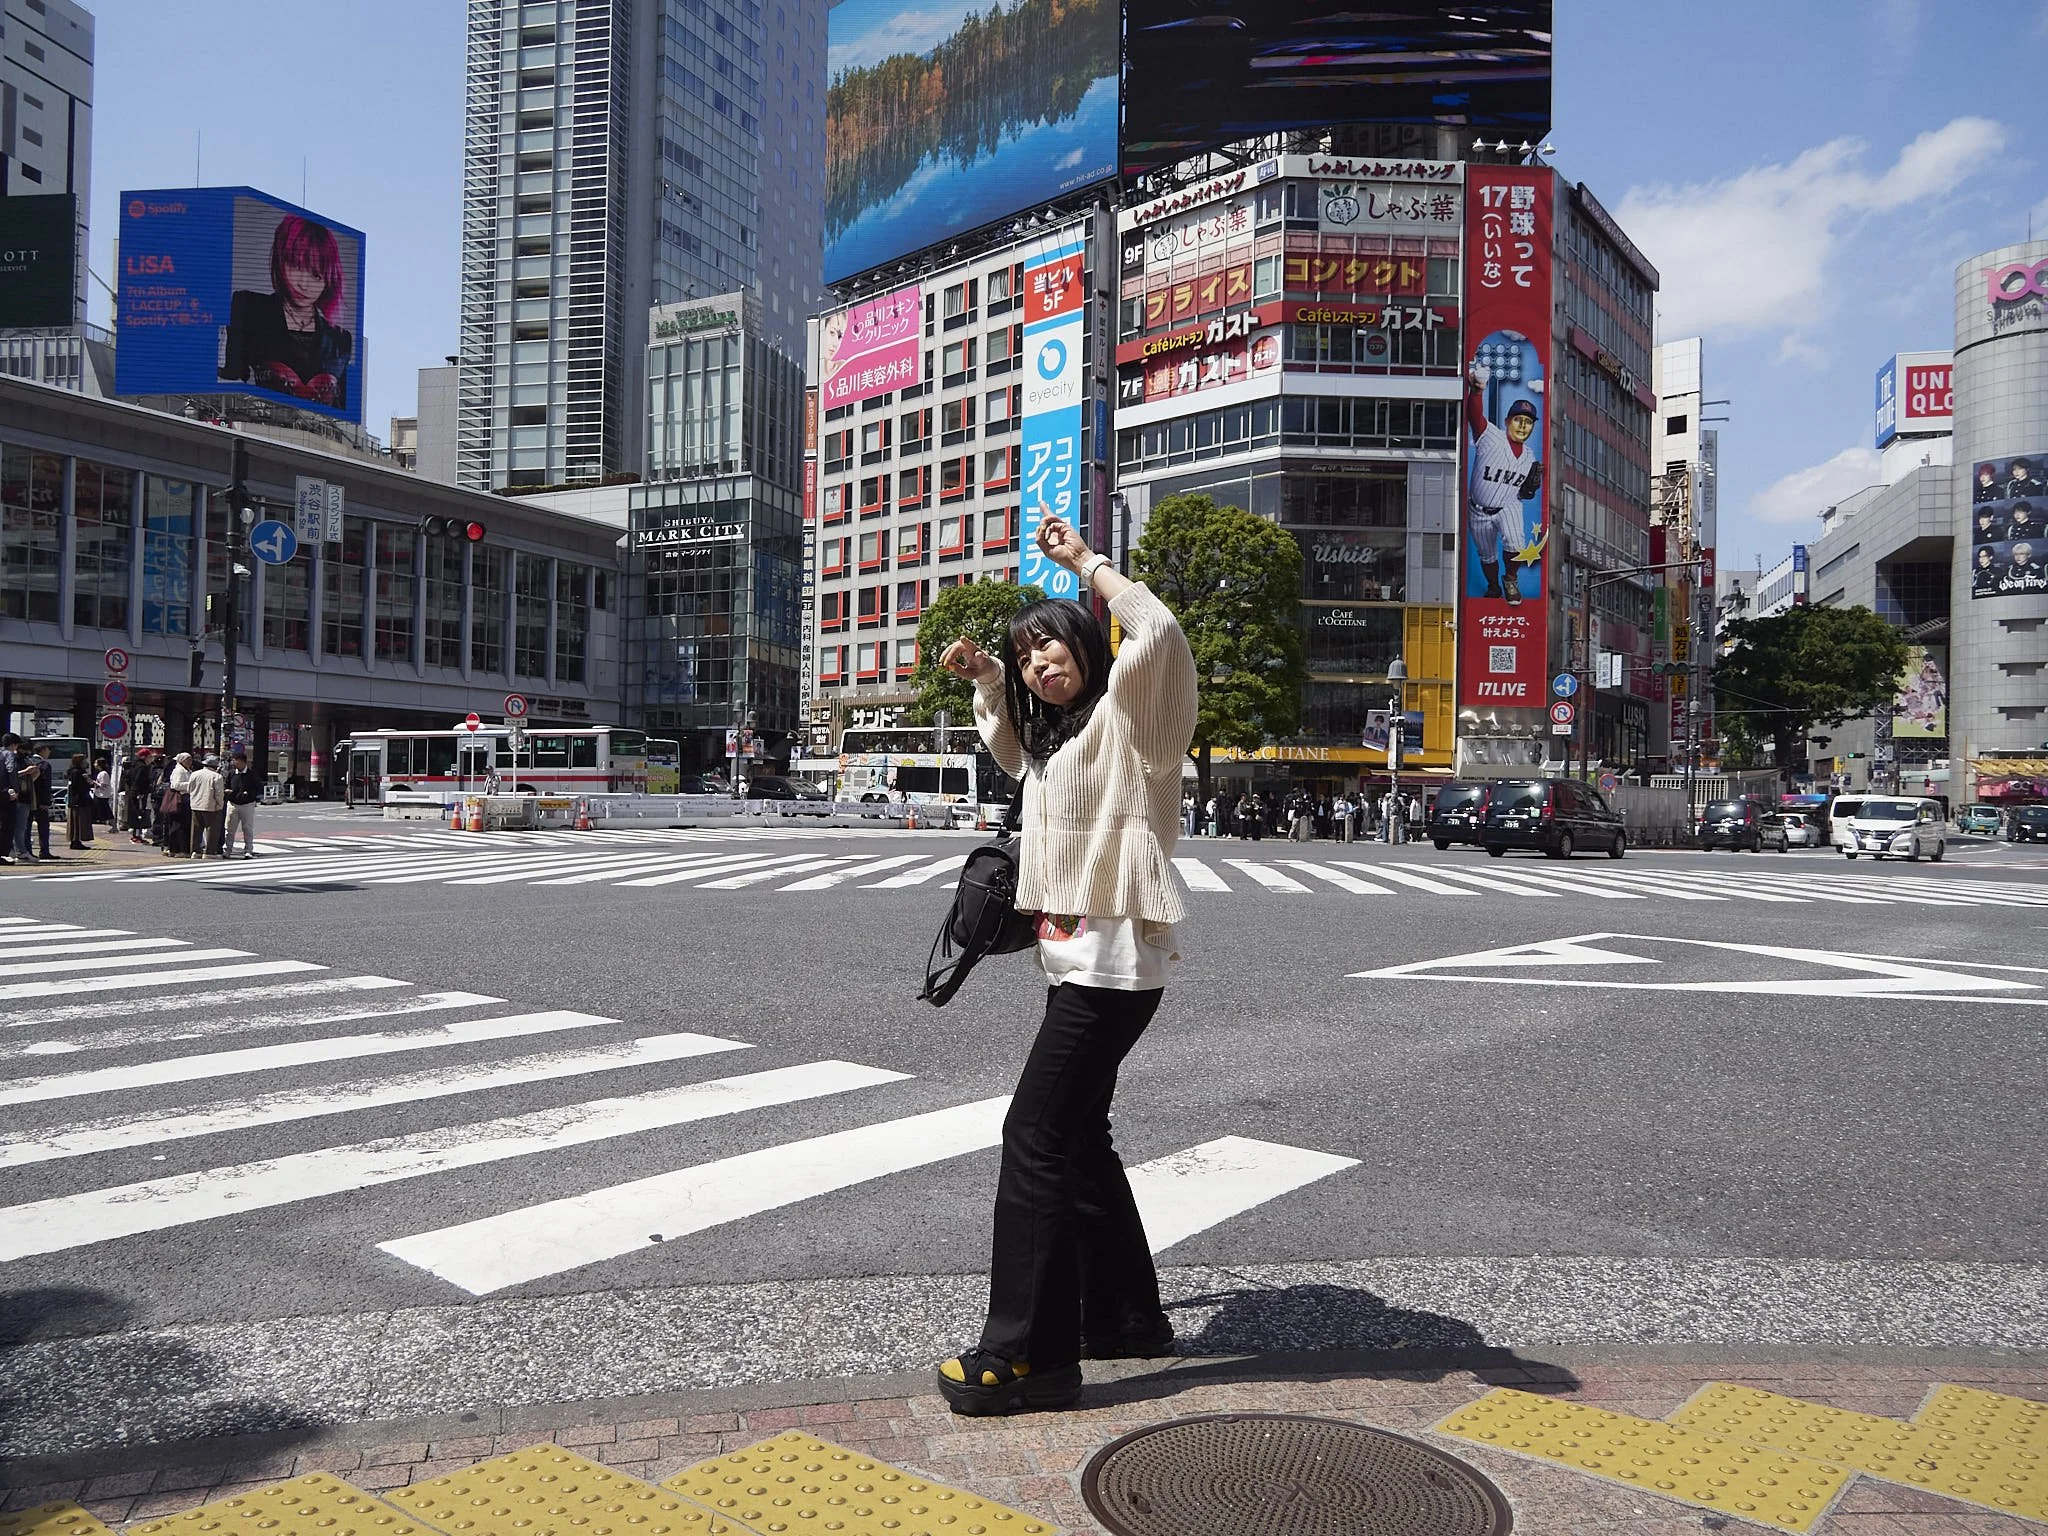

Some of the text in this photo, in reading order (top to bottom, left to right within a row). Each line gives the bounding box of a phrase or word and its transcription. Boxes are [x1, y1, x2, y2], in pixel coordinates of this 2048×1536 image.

[1368, 193, 1455, 222] しゃぶ葉
[1183, 205, 1248, 247] しゃぶ葉
[1510, 185, 1536, 288] 野球って
[127, 255, 175, 275] LiSA
[1124, 245, 1144, 265] 9F
[1033, 267, 1074, 294] 当ビル
[1285, 258, 1421, 287] コンタクト
[1043, 288, 1064, 312] 5F
[1147, 268, 1250, 321] プライス
[864, 297, 916, 327] 品川スキン
[1380, 305, 1445, 331] ガスト
[864, 318, 910, 346] クリニック
[1205, 310, 1259, 346] ガスト
[836, 356, 915, 398] 品川美容外科
[1177, 351, 1242, 393] ガスト
[1028, 380, 1075, 406] eyecity
[1120, 378, 1143, 398] 7F
[308, 484, 322, 540] 渋谷駅前
[329, 487, 340, 541] スクランブル式
[664, 516, 715, 528] SHIBUYA
[1053, 436, 1073, 594] コンタの
[638, 523, 745, 543] MARK CITY
[803, 602, 812, 610] 3F
[1318, 615, 1368, 627] L'OCCITANE
[1478, 615, 1530, 627] イチナナで、
[1483, 626, 1526, 639] 叶えよう。
[1675, 626, 1688, 662] 処方せ
[821, 710, 831, 720] 2F
